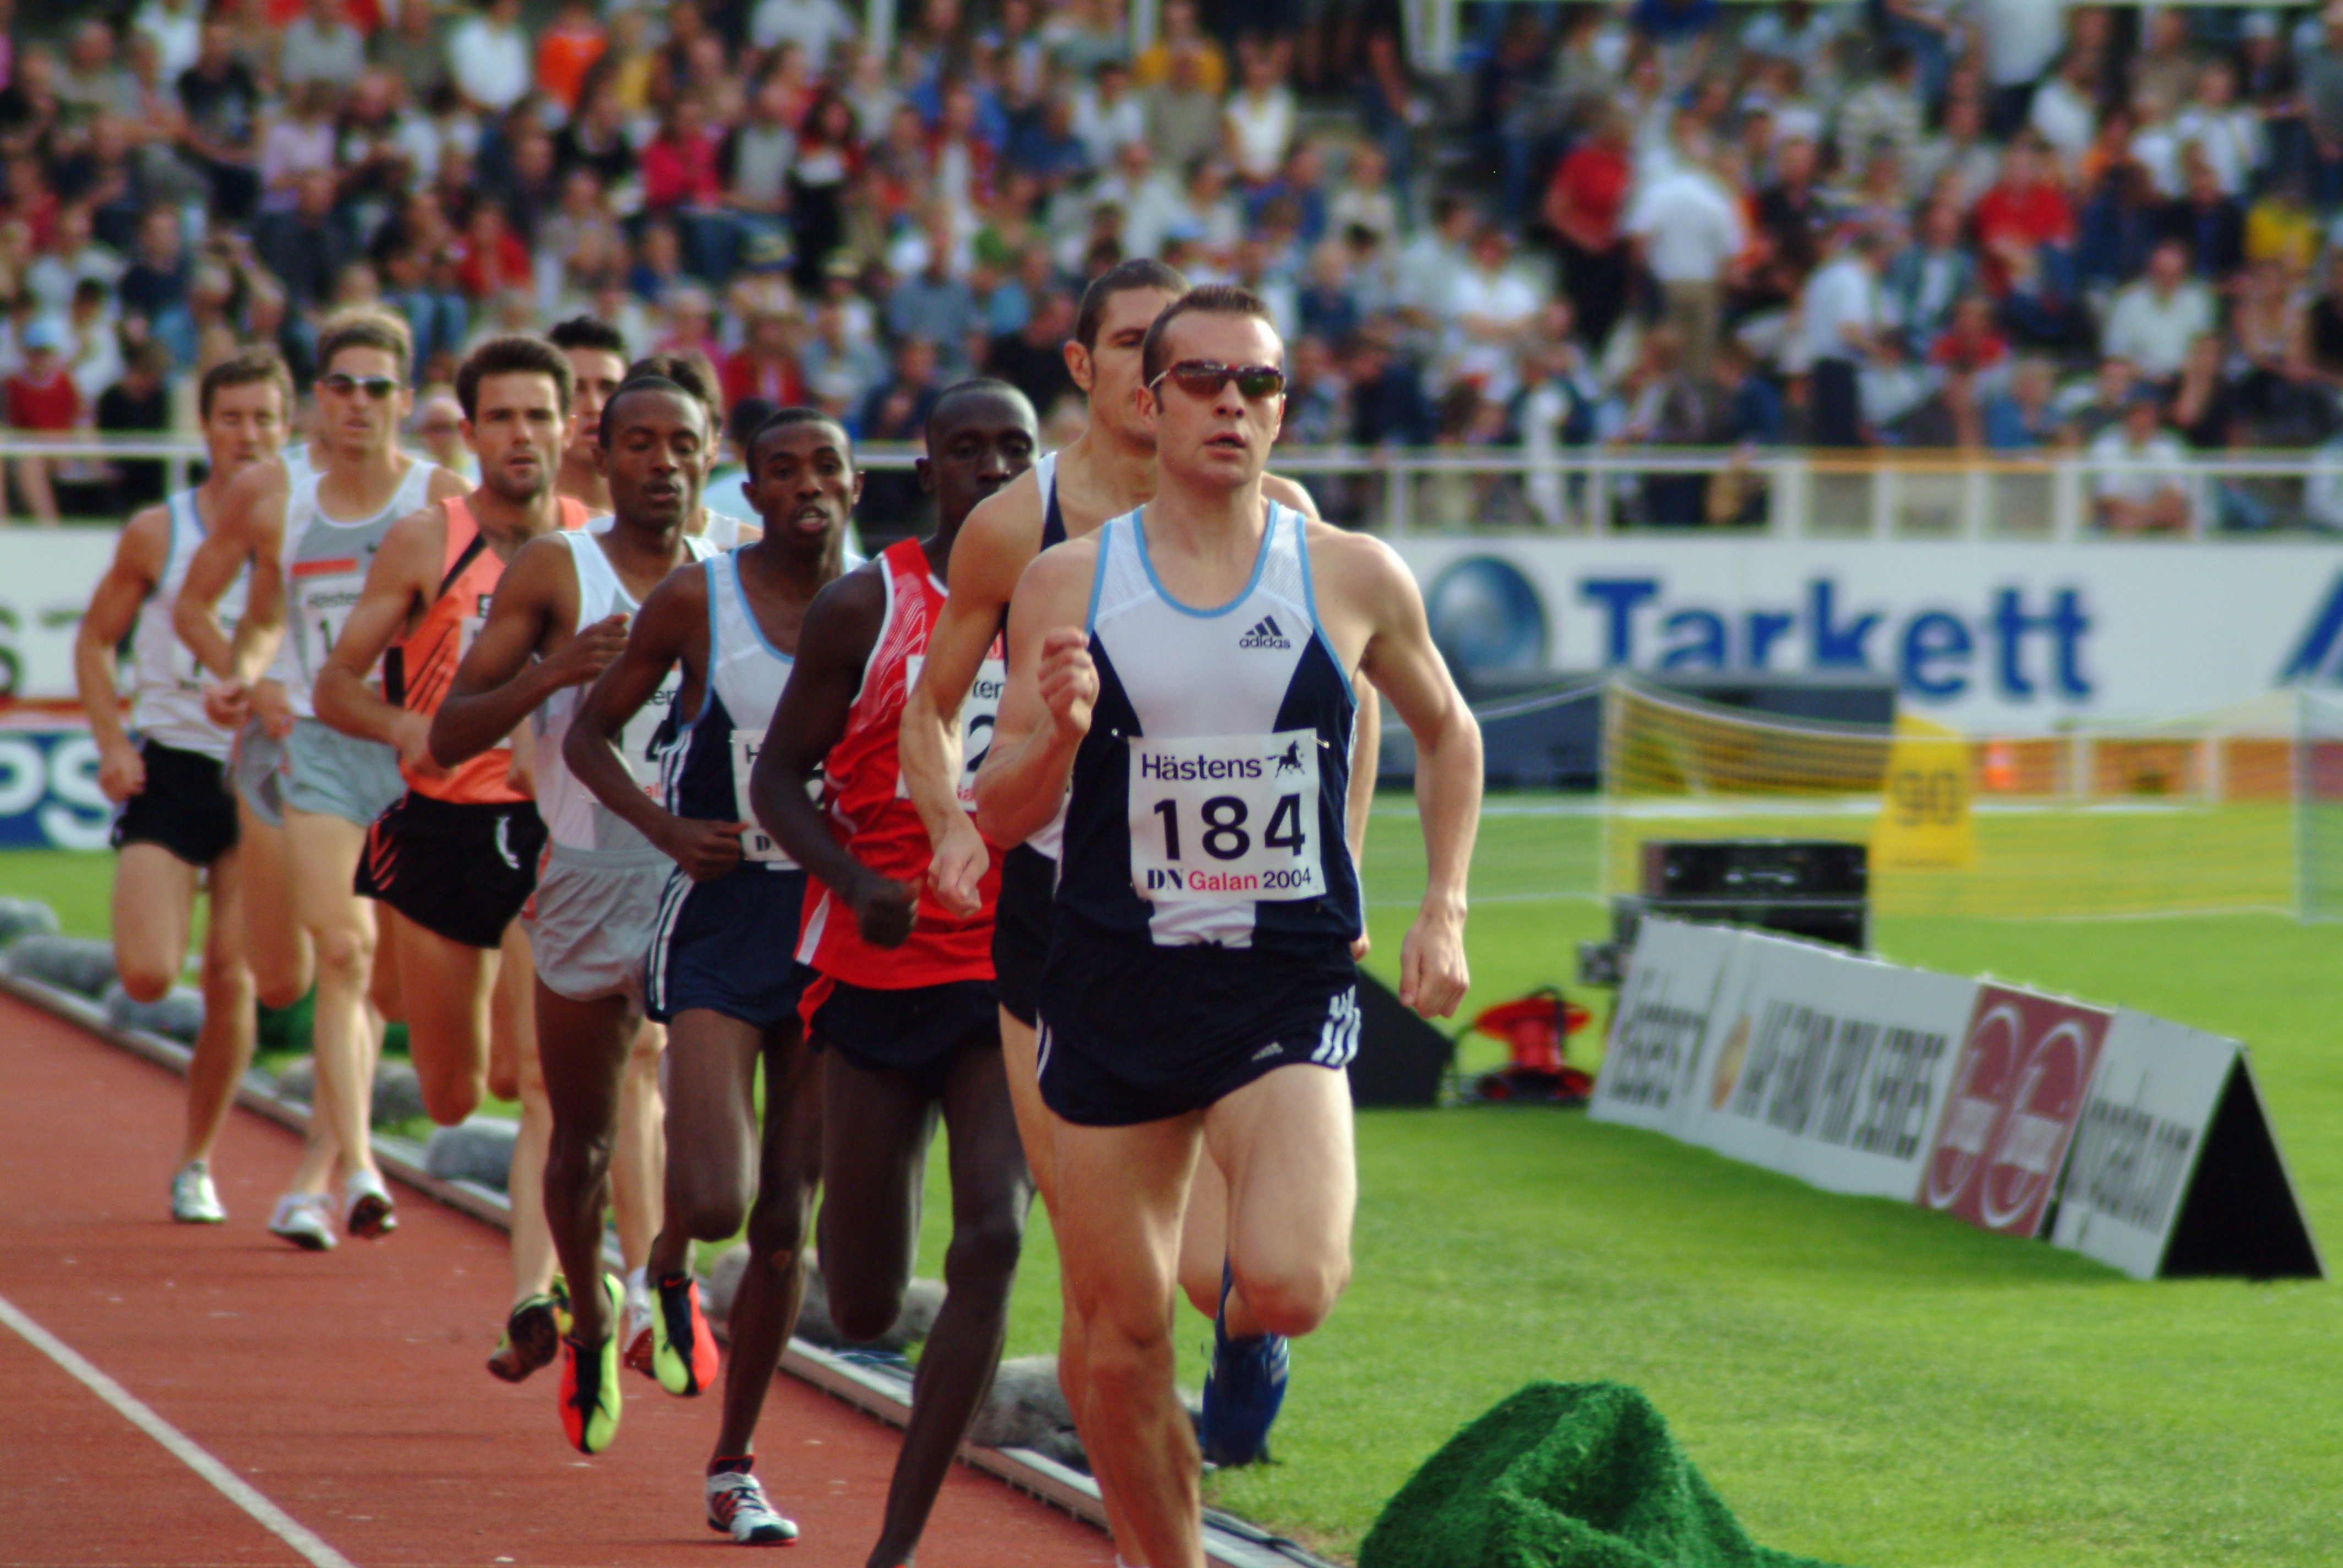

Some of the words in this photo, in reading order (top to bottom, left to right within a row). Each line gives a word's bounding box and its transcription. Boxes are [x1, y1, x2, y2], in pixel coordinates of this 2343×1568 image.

[1239, 636, 1290, 649] adidas
[1578, 578, 2092, 699] Tarkett
[1141, 752, 1262, 781] Hästens
[1154, 793, 1306, 861] 184
[1894, 769, 1962, 827] 90
[1147, 868, 1183, 890] DN
[1188, 870, 1257, 892] Galan
[1262, 866, 1311, 890] 2004
[1851, 1025, 1949, 1162] SERIES
